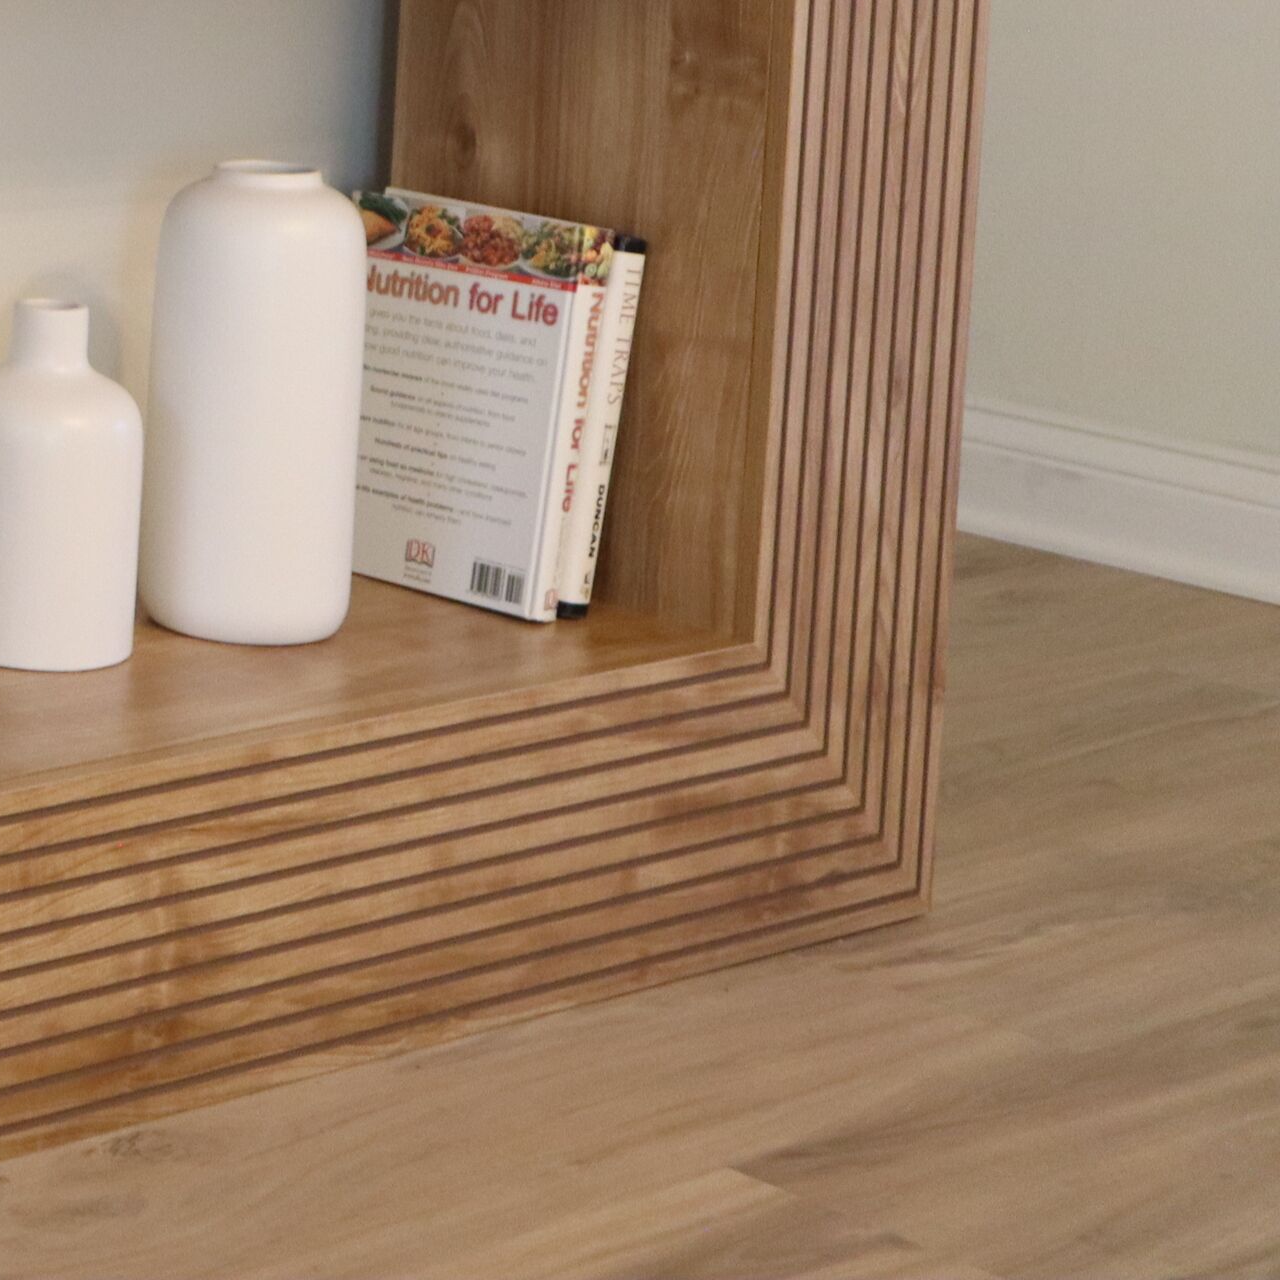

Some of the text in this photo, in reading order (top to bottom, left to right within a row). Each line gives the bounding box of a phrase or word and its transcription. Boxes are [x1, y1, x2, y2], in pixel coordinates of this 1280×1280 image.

[468, 281, 504, 316] for
[511, 290, 559, 326] Life
[619, 268, 641, 324] TIME
[562, 292, 604, 512] Nutrition for Life
[607, 336, 631, 406] TRAPS
[407, 539, 434, 566] DK
[588, 484, 606, 558] DUNCAN
